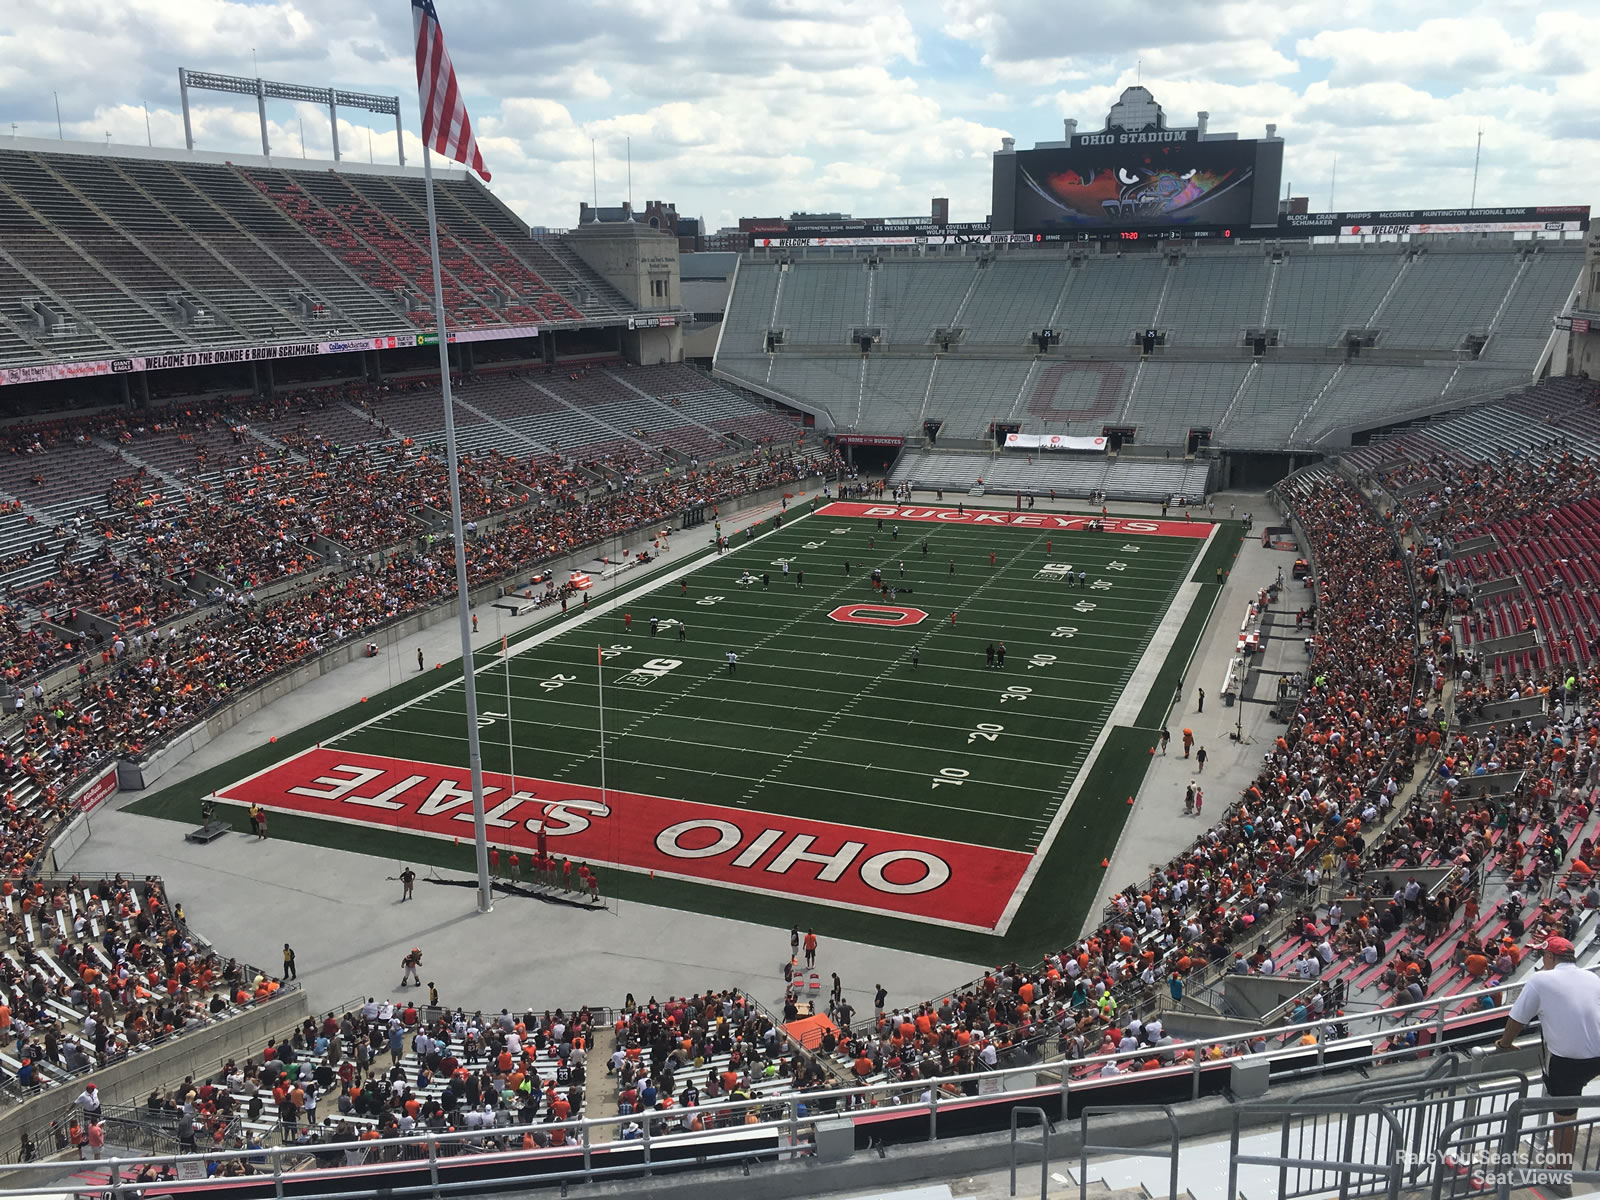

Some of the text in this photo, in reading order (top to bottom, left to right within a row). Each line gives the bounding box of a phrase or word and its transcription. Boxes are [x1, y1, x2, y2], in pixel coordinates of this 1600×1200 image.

[1080, 130, 1188, 146] OHIO STADIUM
[1379, 211, 1415, 219] McCORKLE
[1224, 229, 1231, 238] 0
[1371, 225, 1411, 234] WELCOME
[780, 238, 810, 247] WELCOME
[1036, 234, 1042, 242] 0
[145, 355, 185, 370] WELCOME
[186, 354, 197, 366] TO
[198, 351, 213, 364] THE
[214, 349, 244, 362] ORANGE
[251, 345, 278, 360] BROWN
[278, 343, 320, 357] SCRIMMAGE
[863, 507, 1160, 532] BUCKEYES
[1090, 581, 1113, 590] 30
[1072, 602, 1097, 612] 40
[827, 603, 930, 627] O
[1051, 626, 1079, 638] 50
[601, 644, 633, 658] 30
[1029, 654, 1057, 666] 40
[539, 673, 577, 690] 20
[1001, 686, 1033, 701] 30
[969, 723, 1004, 742] 20
[933, 767, 970, 786] 10
[286, 763, 952, 896] OHIO STATE
[905, 1049, 916, 1059] 73
[558, 1071, 569, 1080] 33
